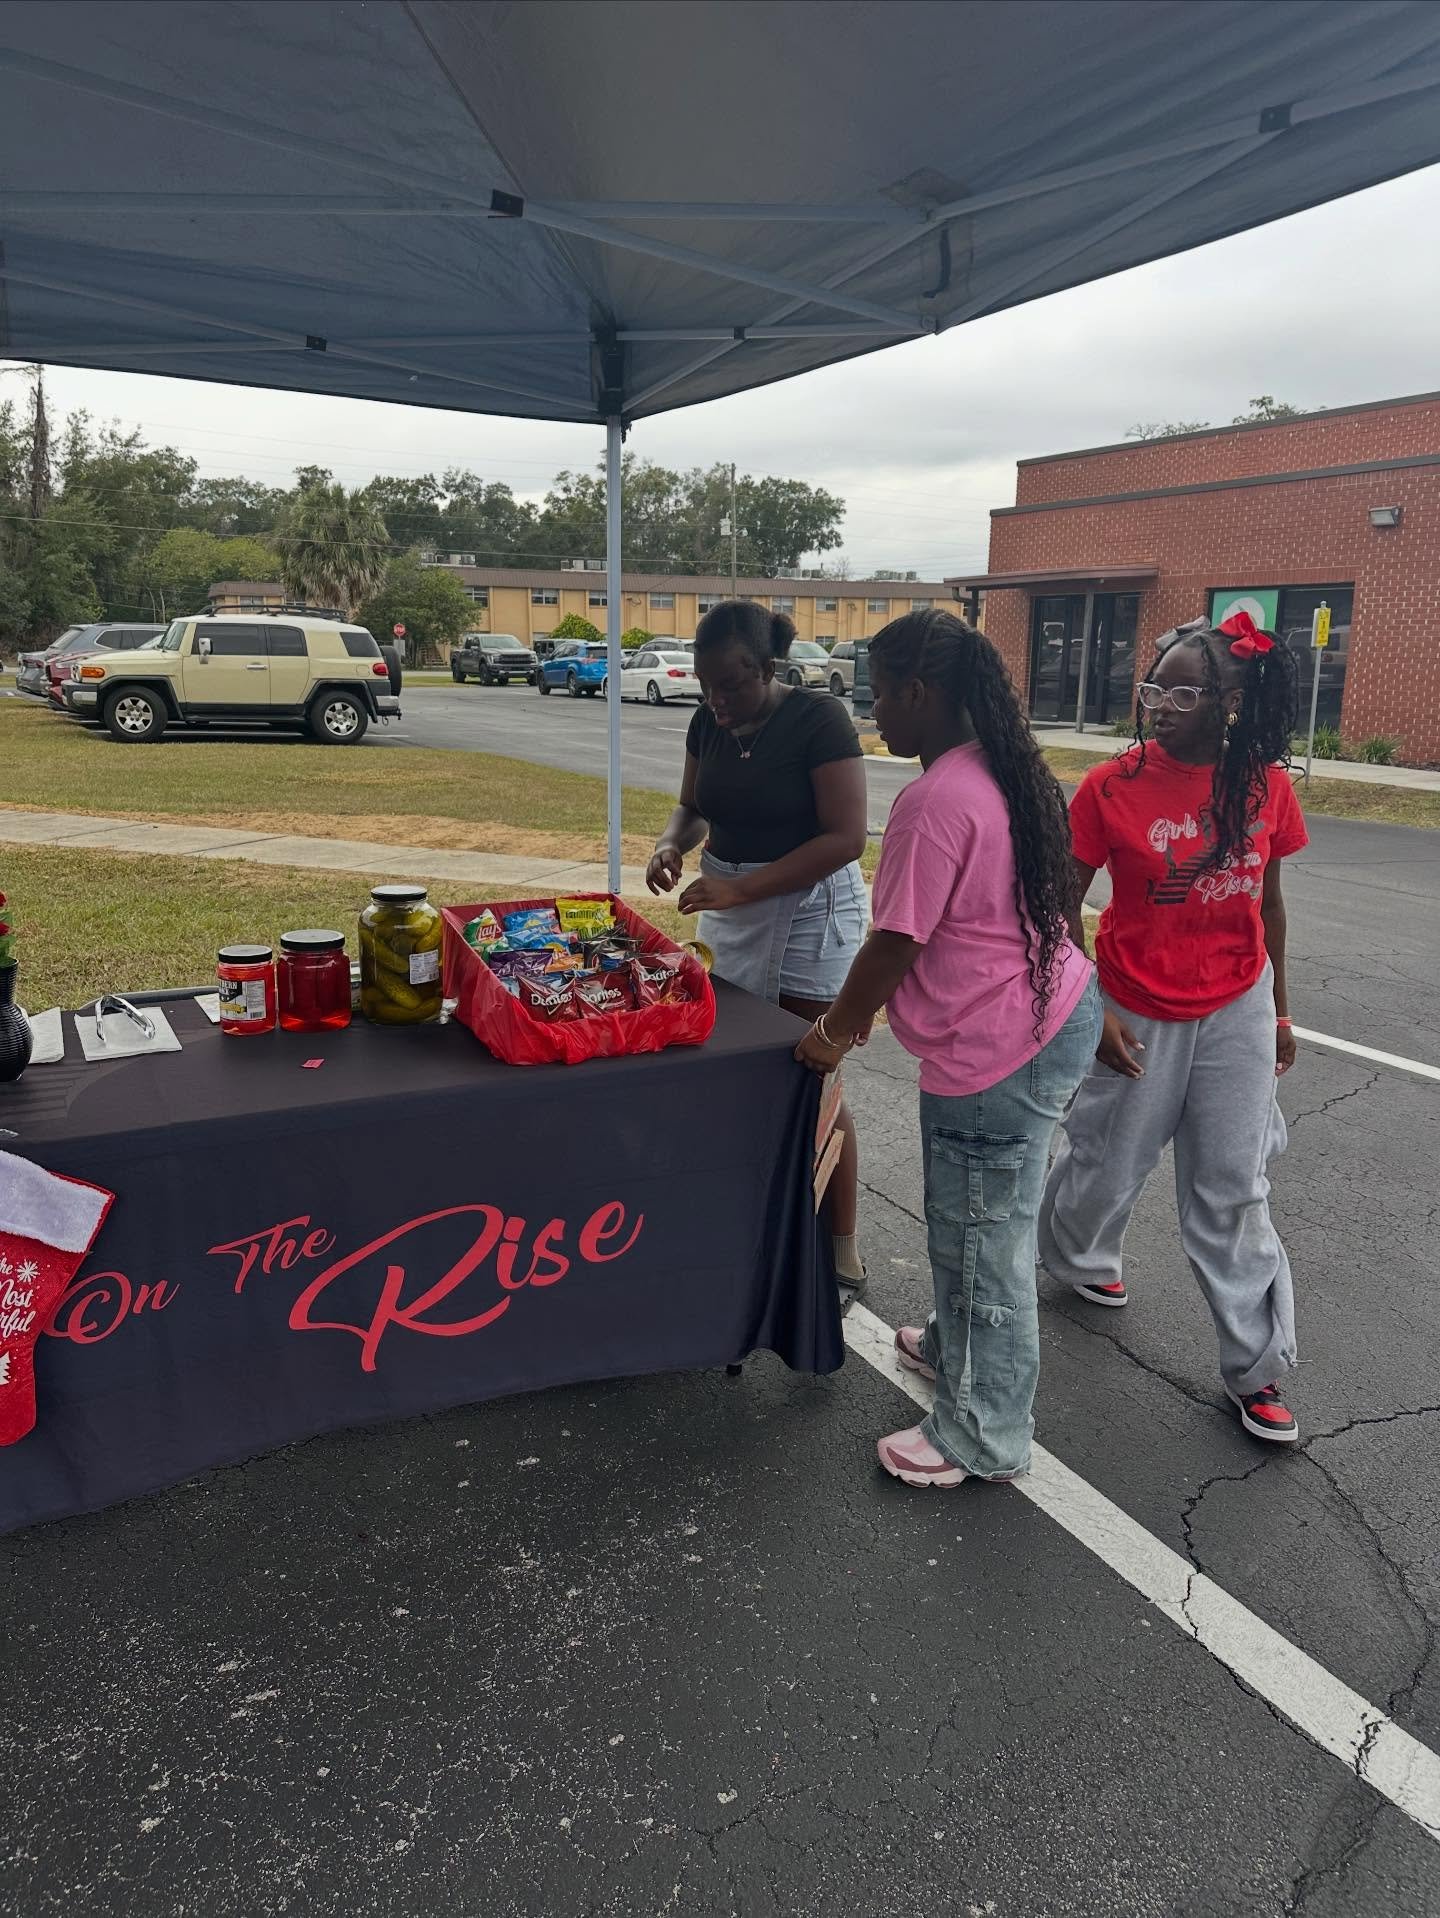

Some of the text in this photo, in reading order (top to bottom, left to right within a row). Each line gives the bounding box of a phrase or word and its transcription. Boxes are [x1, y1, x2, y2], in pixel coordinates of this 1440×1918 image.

[1147, 813, 1198, 853] Girls
[1193, 870, 1256, 904] Rise
[0, 1256, 13, 1275] he
[42, 1201, 644, 1371] On The Rise
